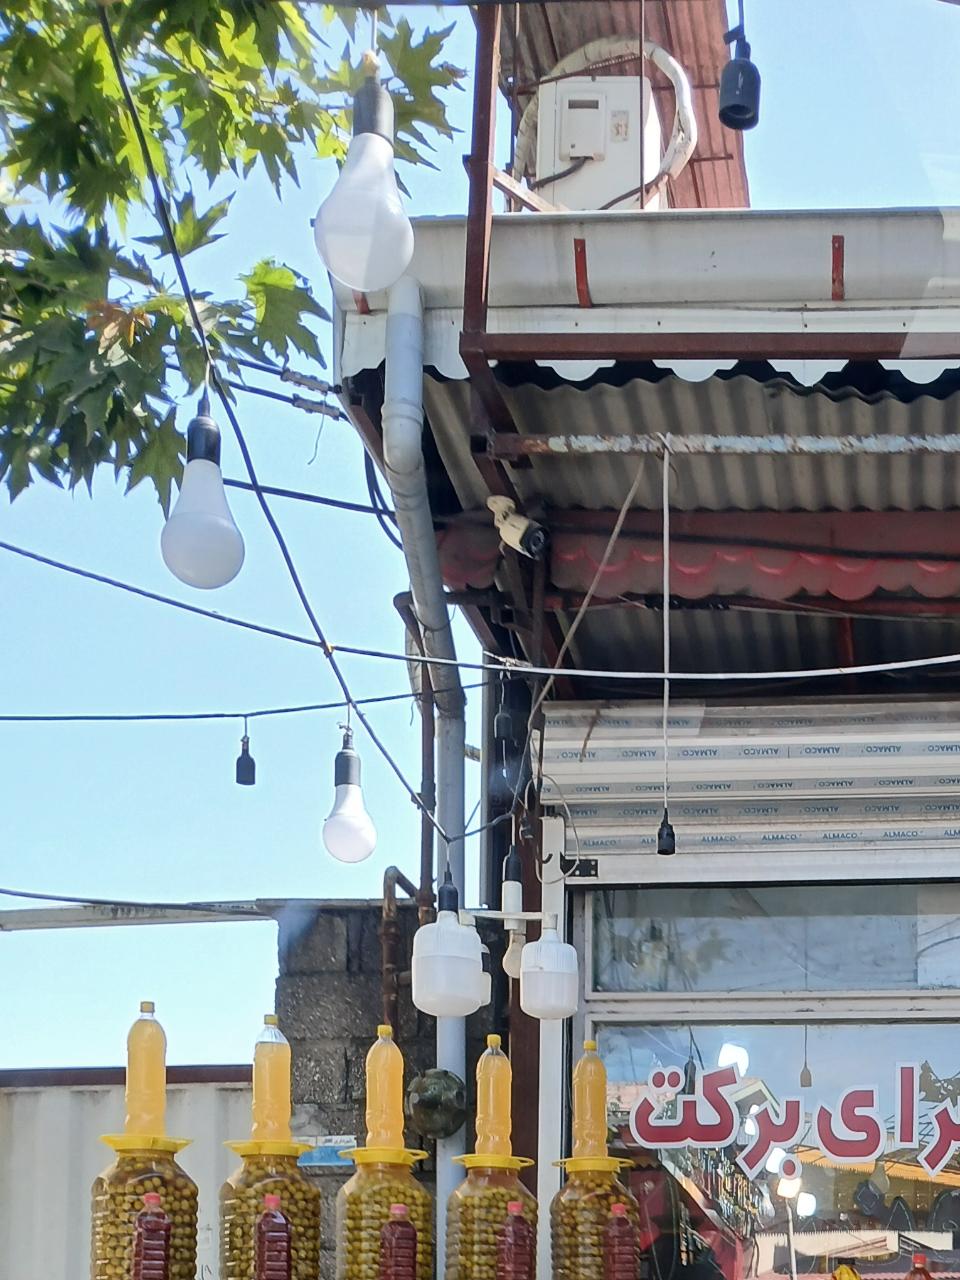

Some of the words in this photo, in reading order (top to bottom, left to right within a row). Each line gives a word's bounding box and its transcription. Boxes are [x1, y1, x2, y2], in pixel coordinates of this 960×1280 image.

[621, 750, 657, 758] ALMACO
[682, 748, 718, 757] ALMACO
[743, 747, 779, 756] ALMACO
[804, 746, 840, 755] ALMACO
[635, 784, 670, 792] ALMACO
[696, 782, 731, 790] ALMACO
[757, 781, 793, 789] ALMACO
[818, 780, 854, 788] ALMACO
[878, 778, 914, 786] ALMACO
[622, 808, 658, 816] ALMACO
[682, 807, 719, 816] ALMACO
[743, 807, 778, 815] ALMACO
[803, 806, 839, 814] ALMACO
[864, 803, 900, 812] ALMACO
[924, 803, 960, 811] ALMACO
[582, 839, 616, 848] ALMACO
[701, 835, 736, 843] ALMACO
[762, 833, 797, 841] ALMACO
[822, 832, 858, 840] ALMACO
[883, 830, 918, 838] ALMACO
[631, 1063, 801, 1178] برکت
